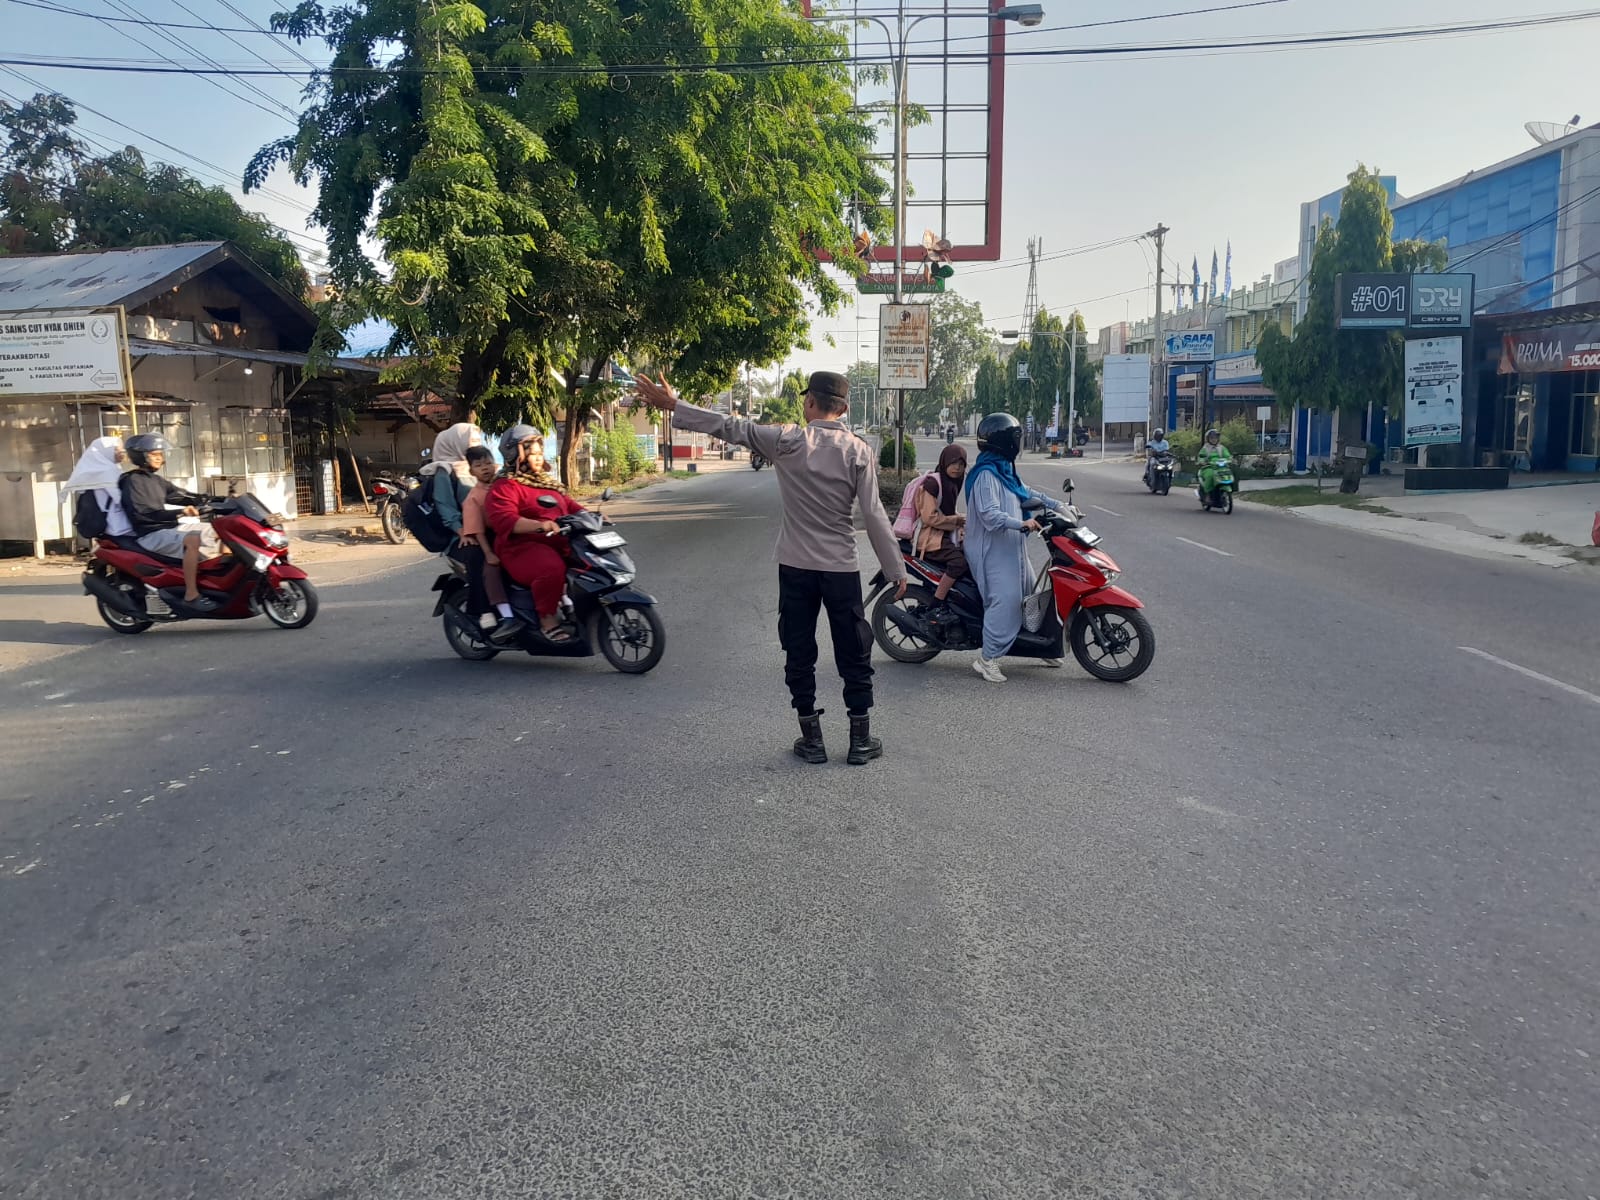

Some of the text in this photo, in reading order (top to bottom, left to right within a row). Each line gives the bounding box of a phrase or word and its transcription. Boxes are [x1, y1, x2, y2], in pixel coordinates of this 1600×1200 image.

[1351, 286, 1405, 312] #01
[1418, 287, 1462, 307] DRY
[5, 325, 27, 334] SAINS
[28, 324, 42, 333] CUT
[44, 323, 62, 332] NYAK
[1183, 334, 1214, 343] SAFA
[0, 353, 50, 361] TERAKREDITASI
[1516, 340, 1564, 362] PRIMA
